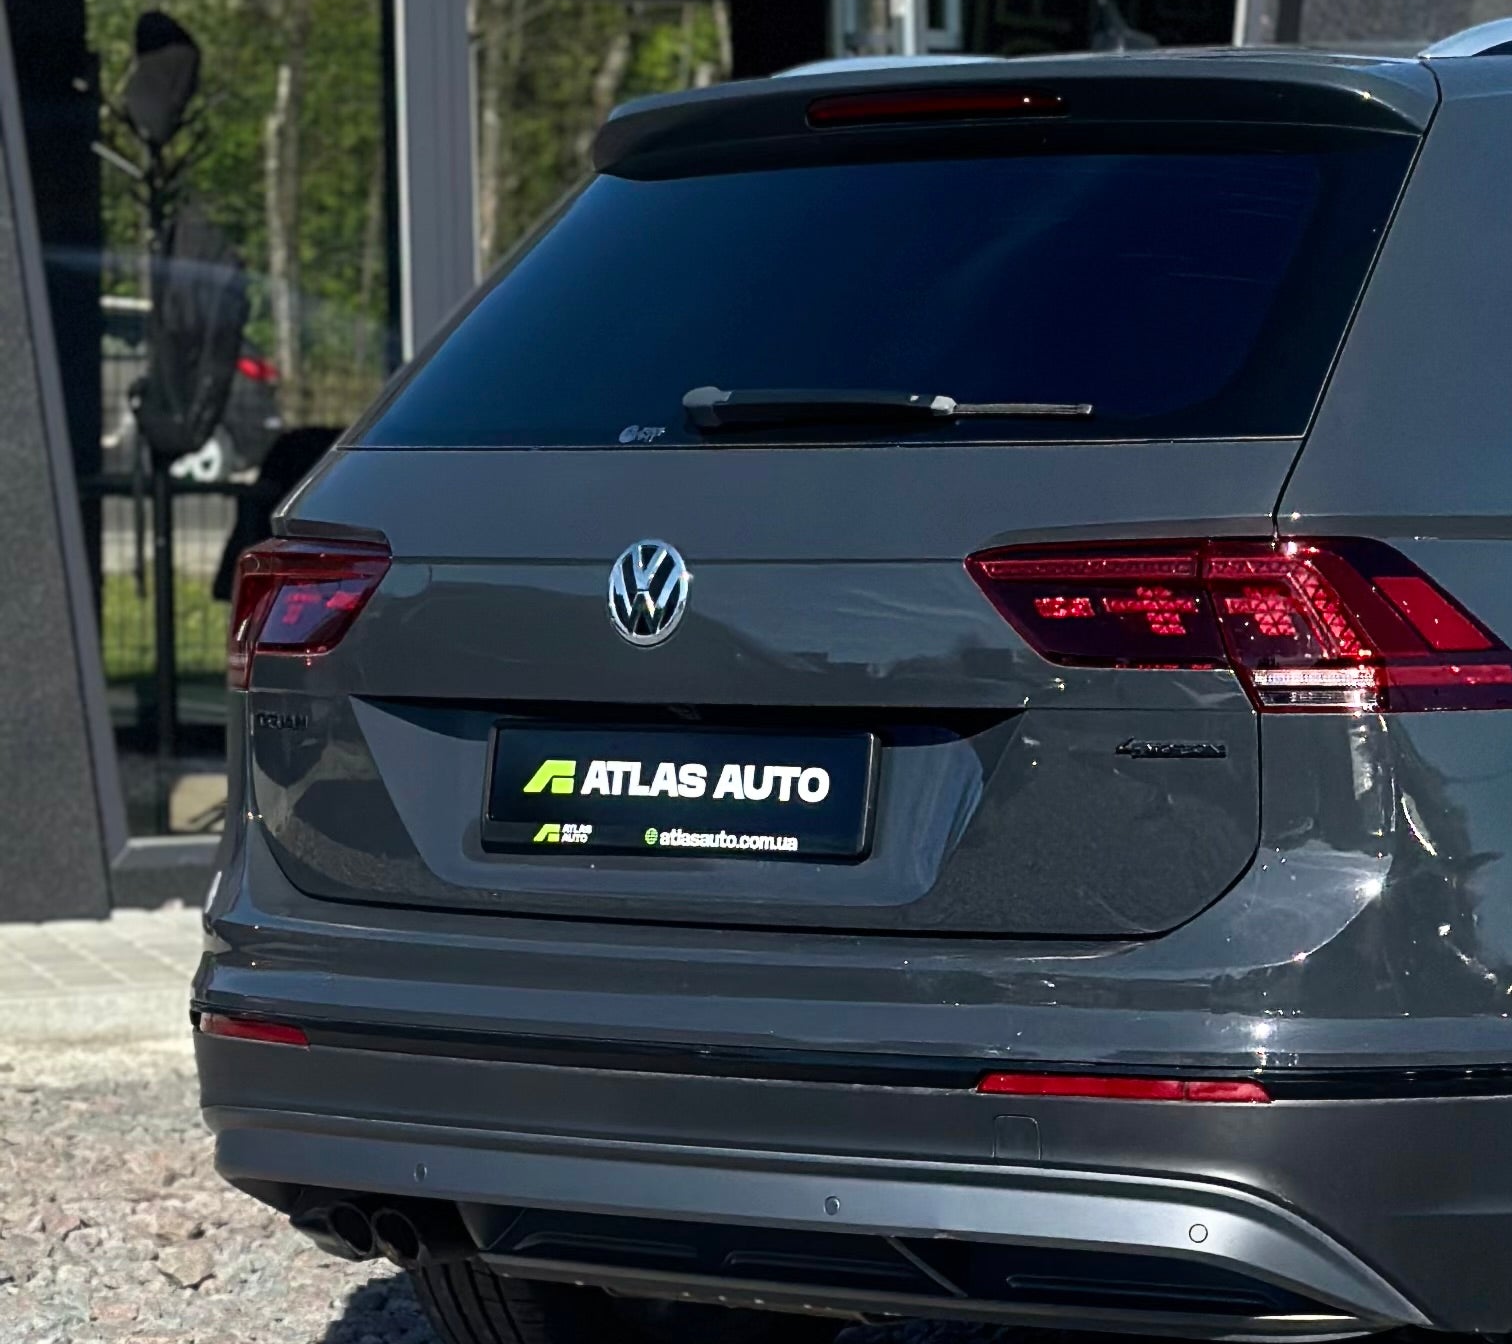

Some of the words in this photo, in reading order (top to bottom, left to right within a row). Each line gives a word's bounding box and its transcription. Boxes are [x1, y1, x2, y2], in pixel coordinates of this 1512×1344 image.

[580, 759, 708, 798] ATLAS
[712, 763, 830, 803] AUTO
[561, 823, 592, 835] ATLAS
[560, 833, 589, 844] AUTO
[659, 828, 799, 852] atlasauto.com.ua
